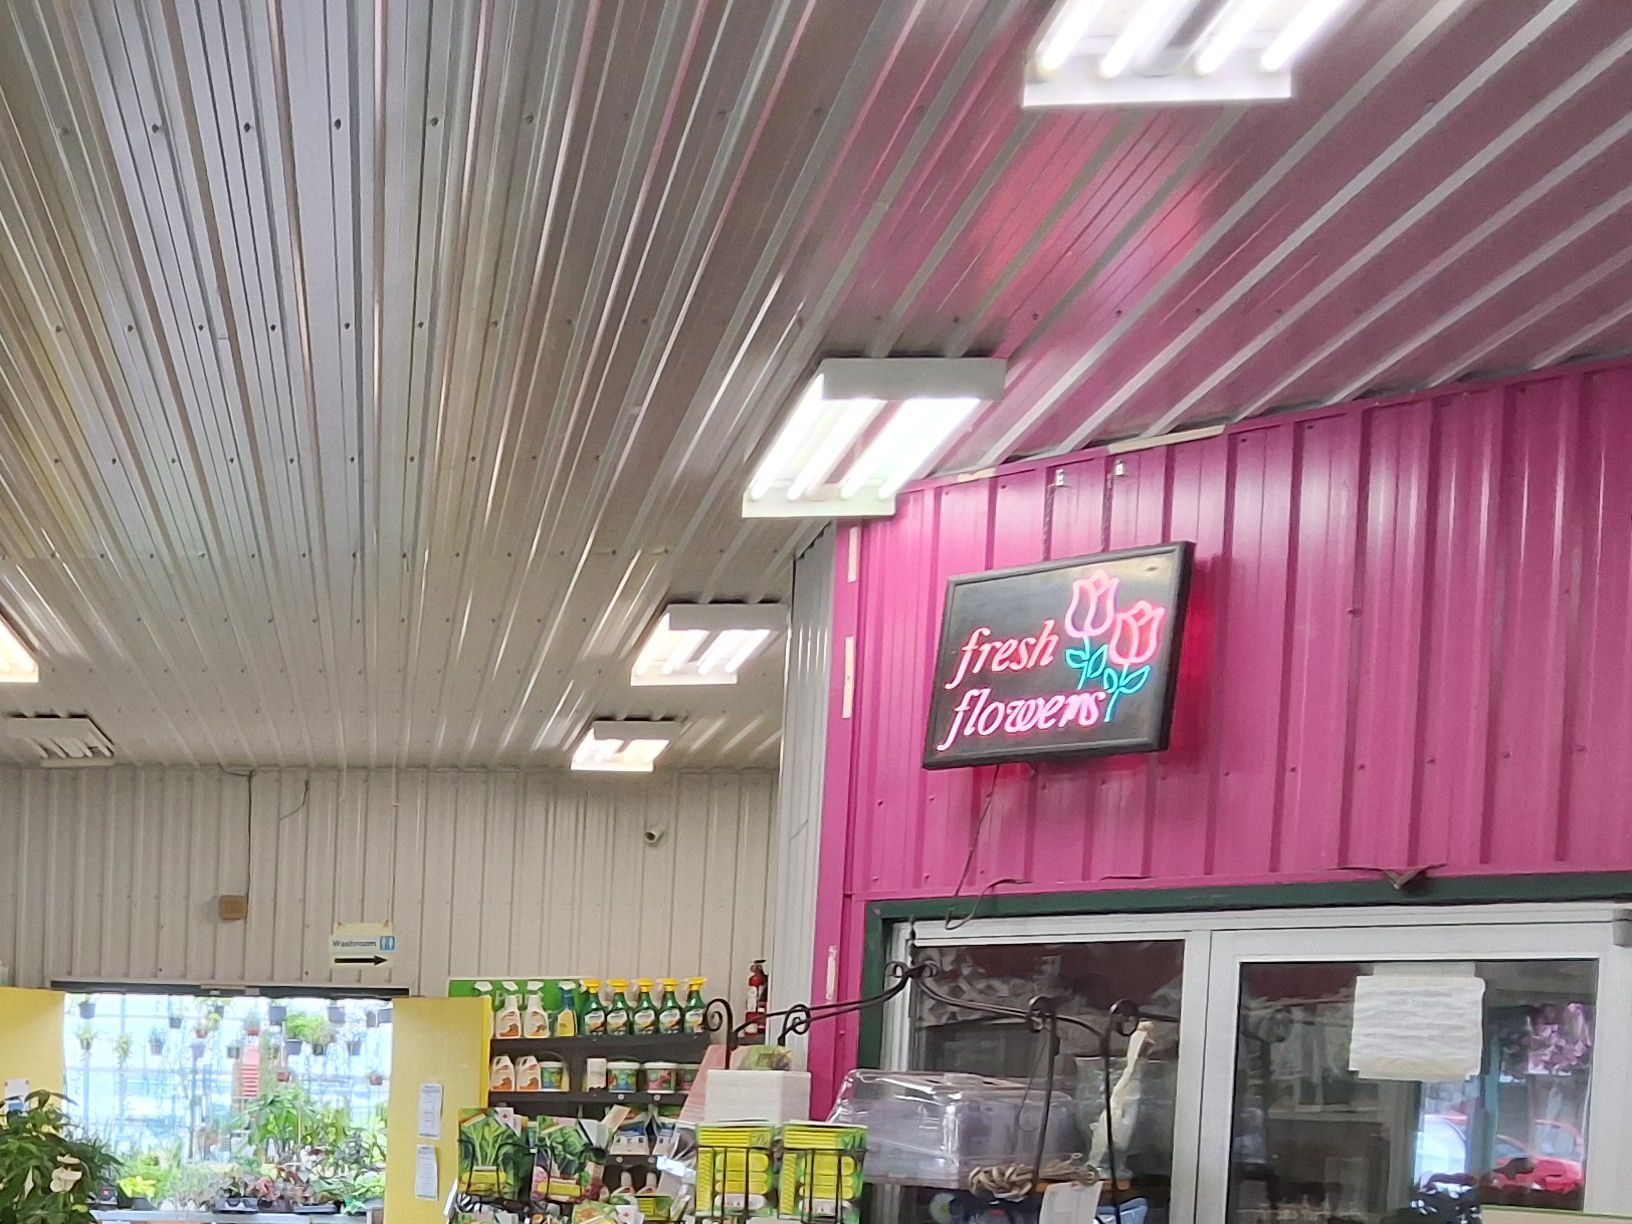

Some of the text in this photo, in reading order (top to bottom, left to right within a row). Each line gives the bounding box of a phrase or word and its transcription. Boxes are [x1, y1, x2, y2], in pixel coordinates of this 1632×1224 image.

[944, 619, 1060, 690] fresh
[936, 688, 1106, 752] flowers
[332, 939, 377, 948] Washroom
